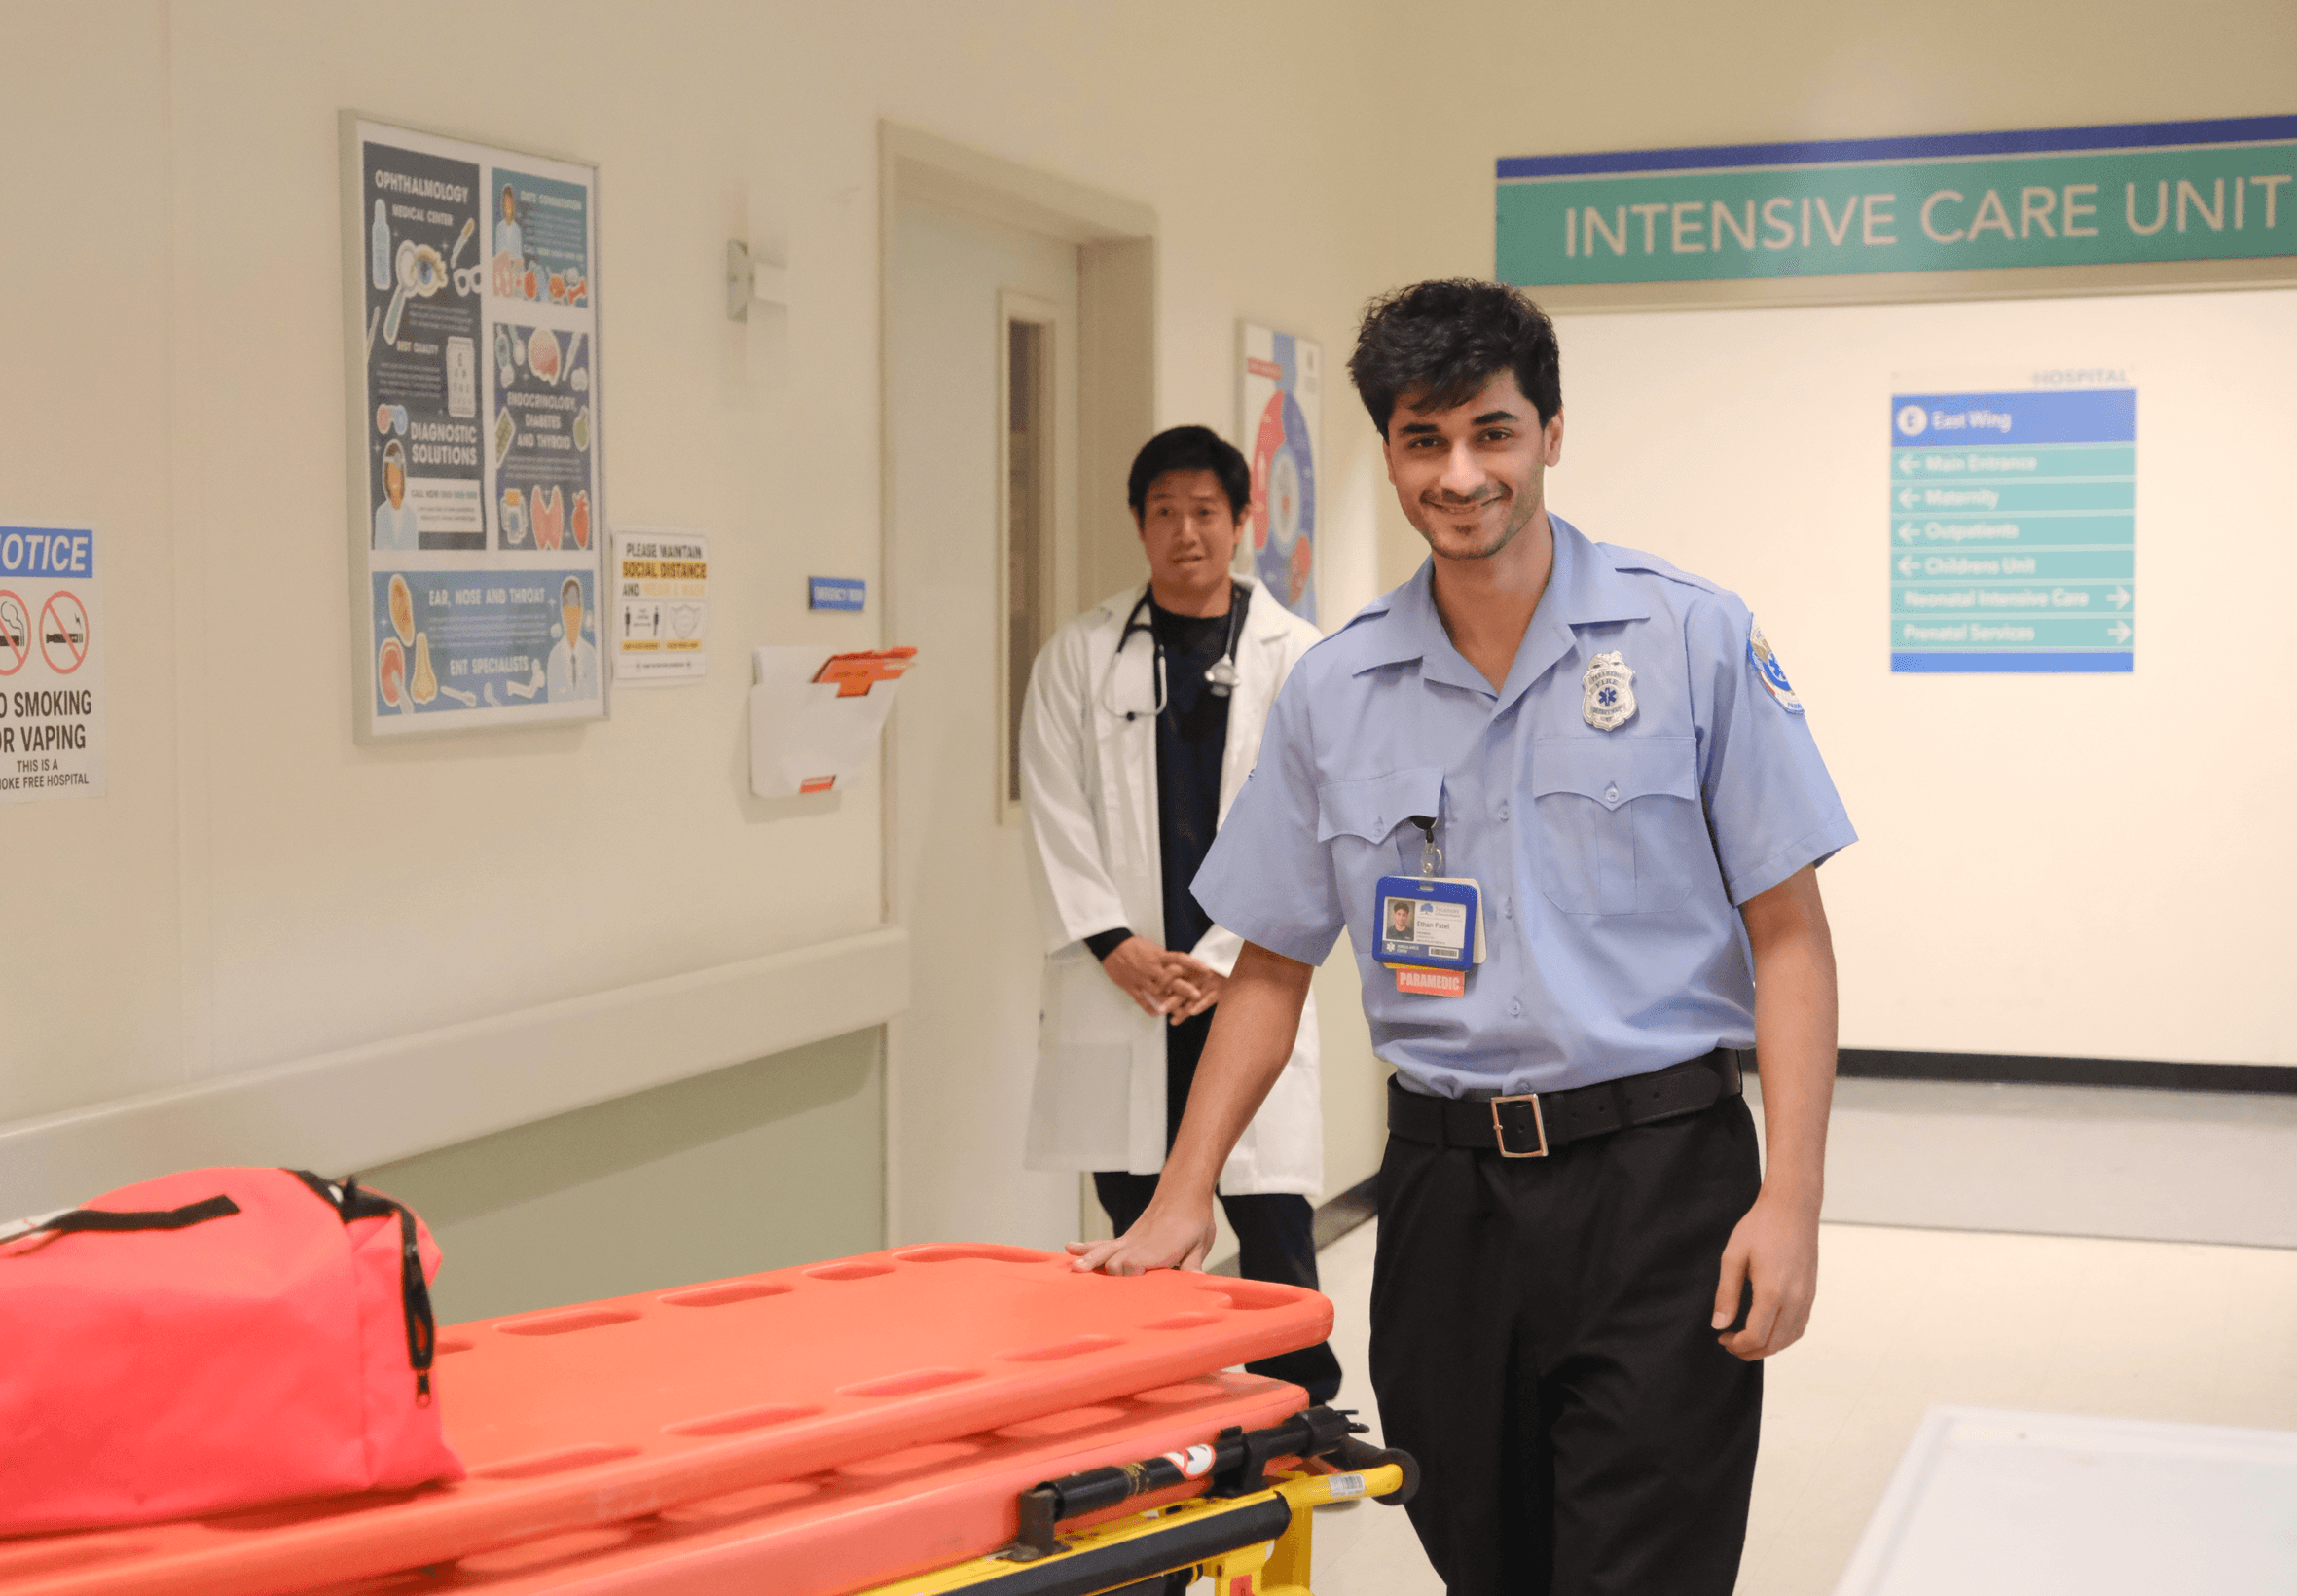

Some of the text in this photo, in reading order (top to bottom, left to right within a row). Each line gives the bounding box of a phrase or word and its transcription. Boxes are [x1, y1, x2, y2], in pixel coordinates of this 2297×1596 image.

[375, 169, 469, 204] OPHTHALMOLOGY
[391, 203, 454, 227] MEDICAL CENTER
[1565, 173, 2293, 257] INTENSIVE CARE UNIT
[2031, 368, 2127, 384] HOSPITAL
[1932, 410, 1966, 430] East
[1968, 410, 2012, 433] Wing
[410, 422, 477, 443] DIAGNOSTIC
[517, 434, 571, 451] AND THYROID
[412, 444, 477, 466] SOLUTIONS
[1926, 454, 2037, 473] Main Entrance
[1925, 488, 1999, 511] Maternity
[1924, 522, 2019, 543] Outpatients
[0, 532, 89, 572] OTICE
[626, 542, 702, 560] PLEASE MAINTAIN
[623, 561, 707, 580] SOCIAL DISTANCE
[2001, 556, 2036, 575] Unit
[428, 587, 545, 607] EAR, NOSE AND THROAT
[622, 583, 640, 598] AND
[1904, 587, 2090, 607] Neonatal Intensive Care
[1969, 623, 2035, 642] Services
[450, 656, 529, 676] ENT SPECIALISTS
[1595, 678, 1619, 688] FIRE
[0, 689, 91, 719] O SMOKING
[0, 723, 86, 754] R VAPING
[17, 757, 58, 773] THIS IS A
[0, 772, 90, 790] OKE FREE HOSPITAL
[1416, 920, 1450, 930] Ethan Patel
[1400, 971, 1460, 991] PARAMEDIC
